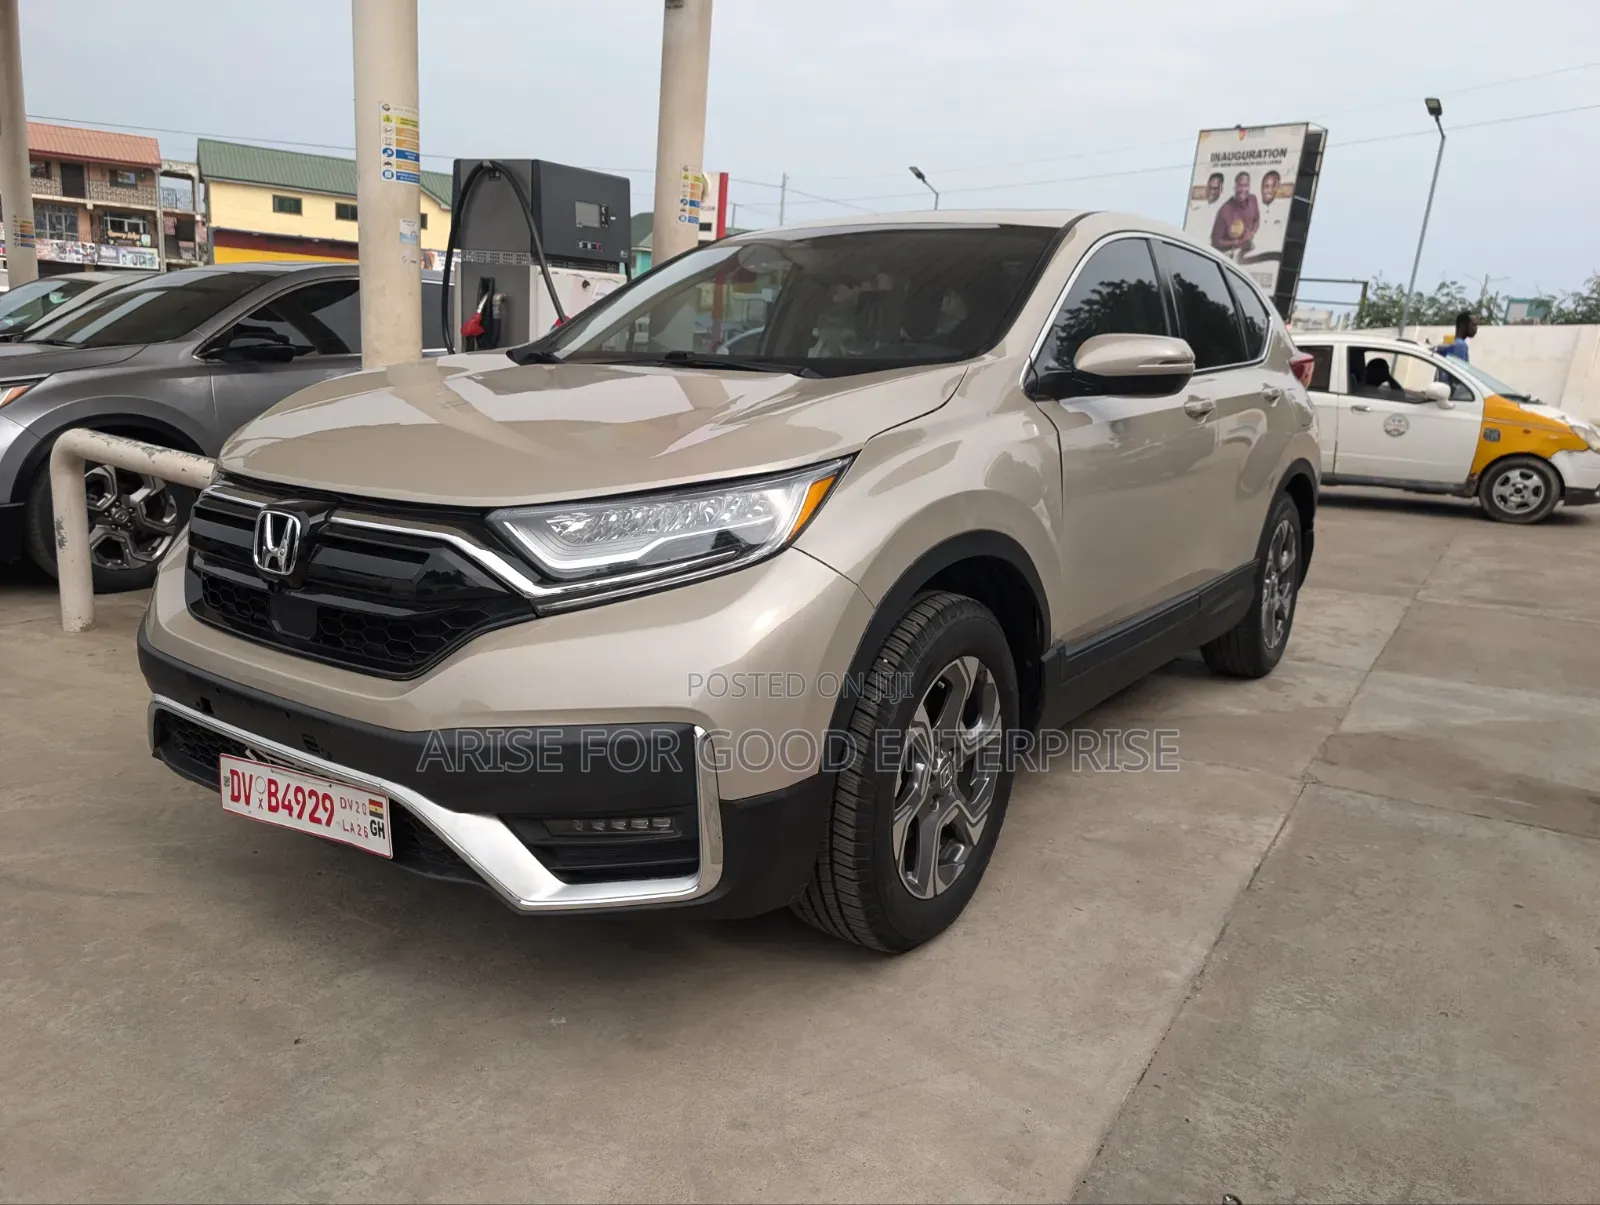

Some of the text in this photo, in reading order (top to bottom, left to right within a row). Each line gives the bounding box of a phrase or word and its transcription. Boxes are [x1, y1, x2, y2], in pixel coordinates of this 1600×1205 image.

[1210, 147, 1288, 162] INAUGURATION
[230, 768, 253, 807] DV
[267, 778, 335, 828] B4929
[339, 796, 367, 816] DV20
[341, 819, 369, 839] LA26
[370, 819, 386, 840] GH
